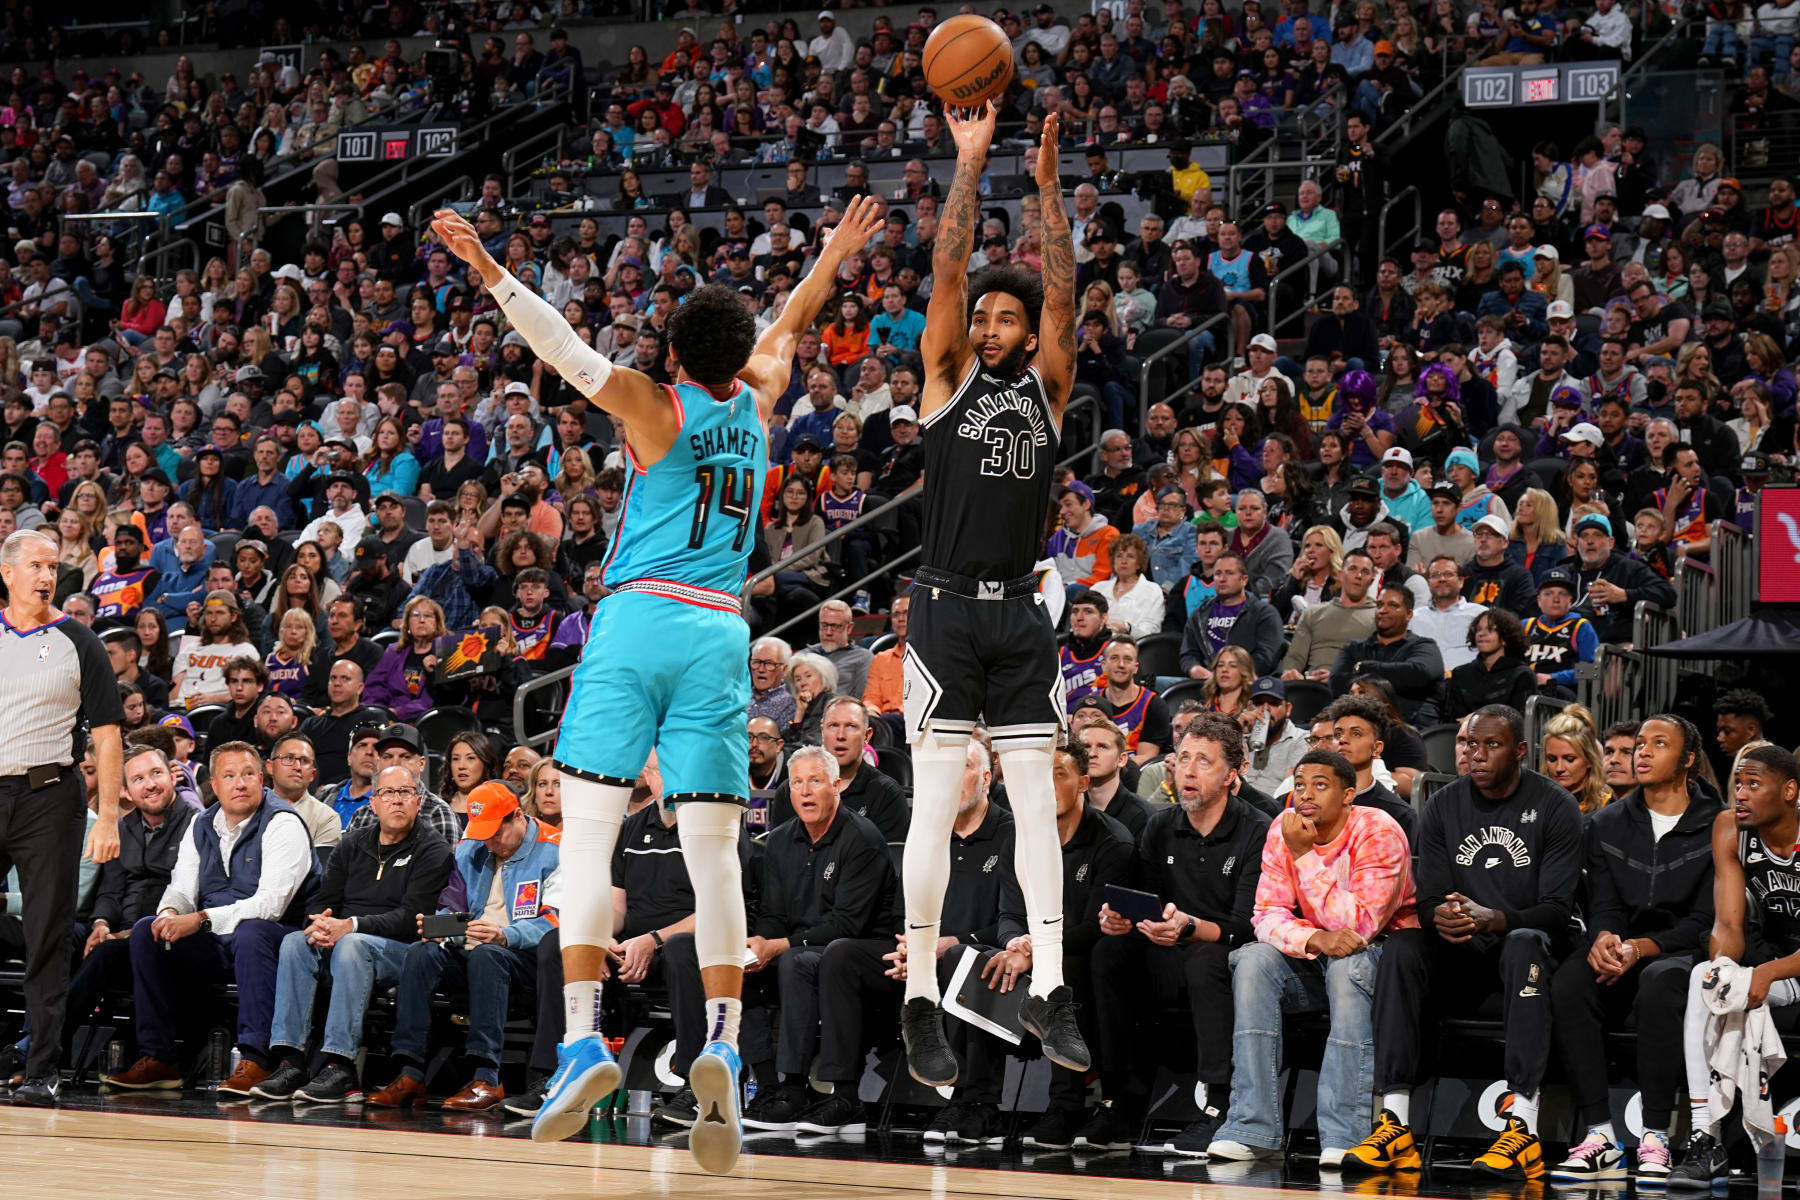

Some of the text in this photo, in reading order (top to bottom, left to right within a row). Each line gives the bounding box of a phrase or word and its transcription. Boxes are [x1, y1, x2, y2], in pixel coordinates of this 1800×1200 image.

[951, 60, 1006, 99] Wilson
[1475, 79, 1506, 100] 102
[1528, 79, 1555, 100] EXIT
[1578, 73, 1610, 97] 103
[345, 137, 368, 157] 101
[385, 140, 407, 159] EXIT
[958, 393, 1001, 440] SAN
[689, 426, 758, 460] SHAMET
[981, 427, 1035, 479] 30
[688, 465, 754, 552] 14
[1456, 826, 1531, 867] SAN ANTONIO
[1749, 837, 1757, 849] 6
